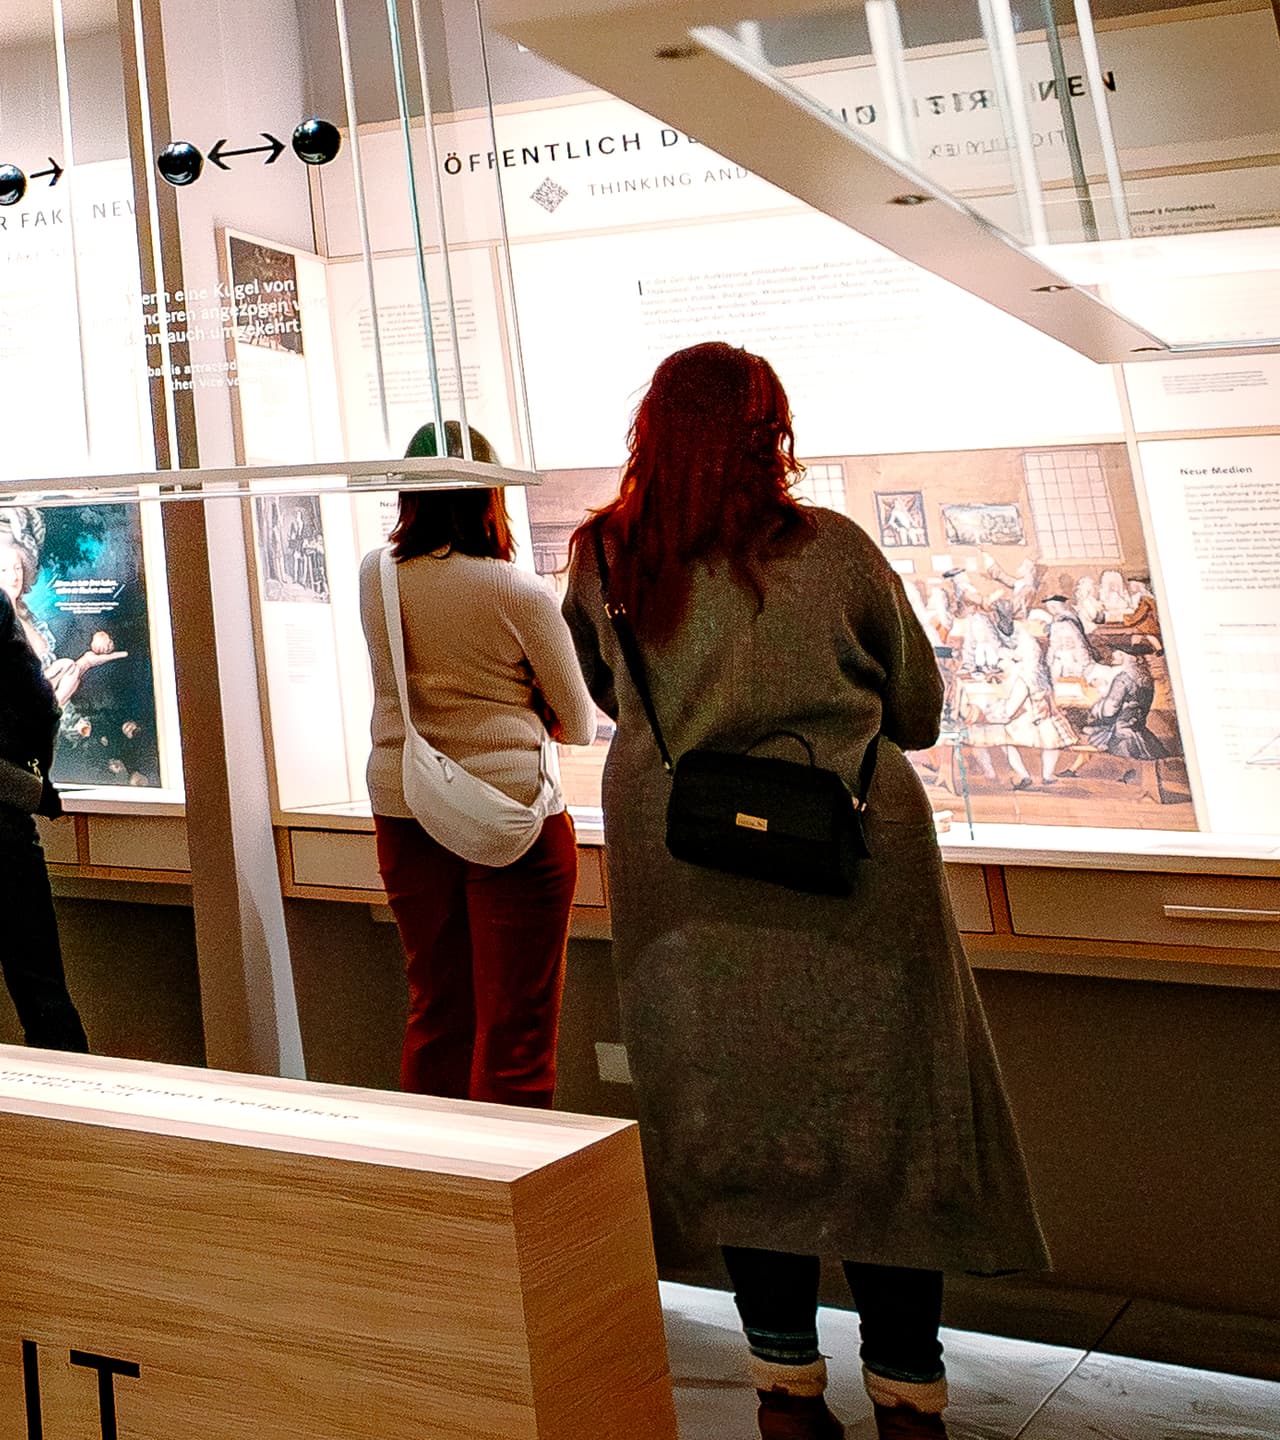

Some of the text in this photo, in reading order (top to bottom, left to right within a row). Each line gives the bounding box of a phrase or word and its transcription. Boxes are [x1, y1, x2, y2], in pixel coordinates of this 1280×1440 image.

[443, 132, 642, 176] ÖFFENTLICH
[587, 166, 749, 198] THINKING AND
[20, 208, 76, 229] FAK
[213, 278, 259, 300] Kugel
[263, 279, 295, 293] von
[200, 299, 289, 323] angezogen
[167, 326, 205, 344] auch
[1180, 467, 1208, 476] Neue
